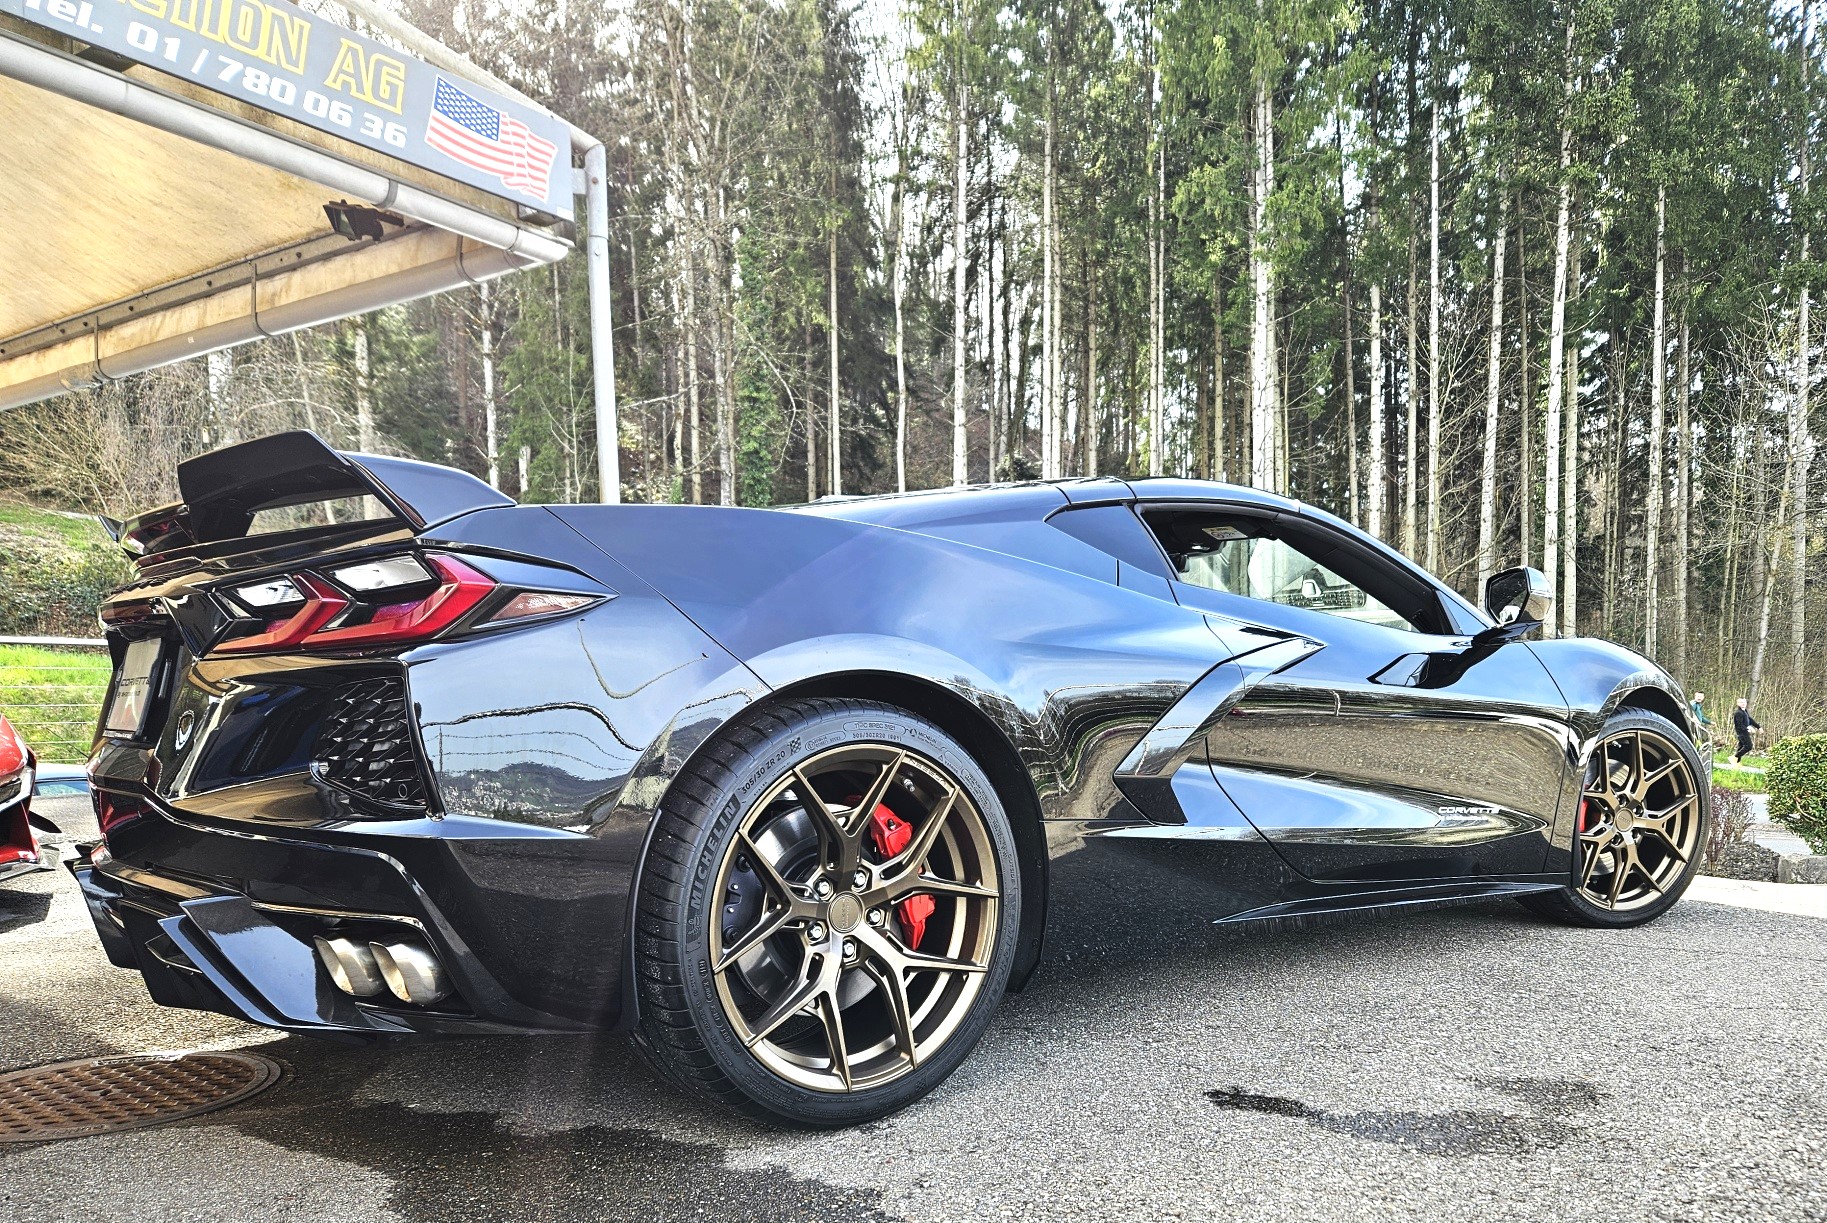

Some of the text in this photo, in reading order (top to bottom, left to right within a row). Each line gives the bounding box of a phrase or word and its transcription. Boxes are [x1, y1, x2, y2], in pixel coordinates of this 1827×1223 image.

[127, 21, 181, 62] 01
[218, 55, 297, 106] 780
[303, 90, 354, 128] 06
[360, 112, 407, 148] 36
[324, 37, 405, 115] AG
[741, 767, 766, 795] 305/30
[765, 758, 776, 770] ZR
[776, 750, 786, 761] 20
[1438, 806, 1500, 814] CORVETTE
[689, 801, 738, 910] MICHELIN
